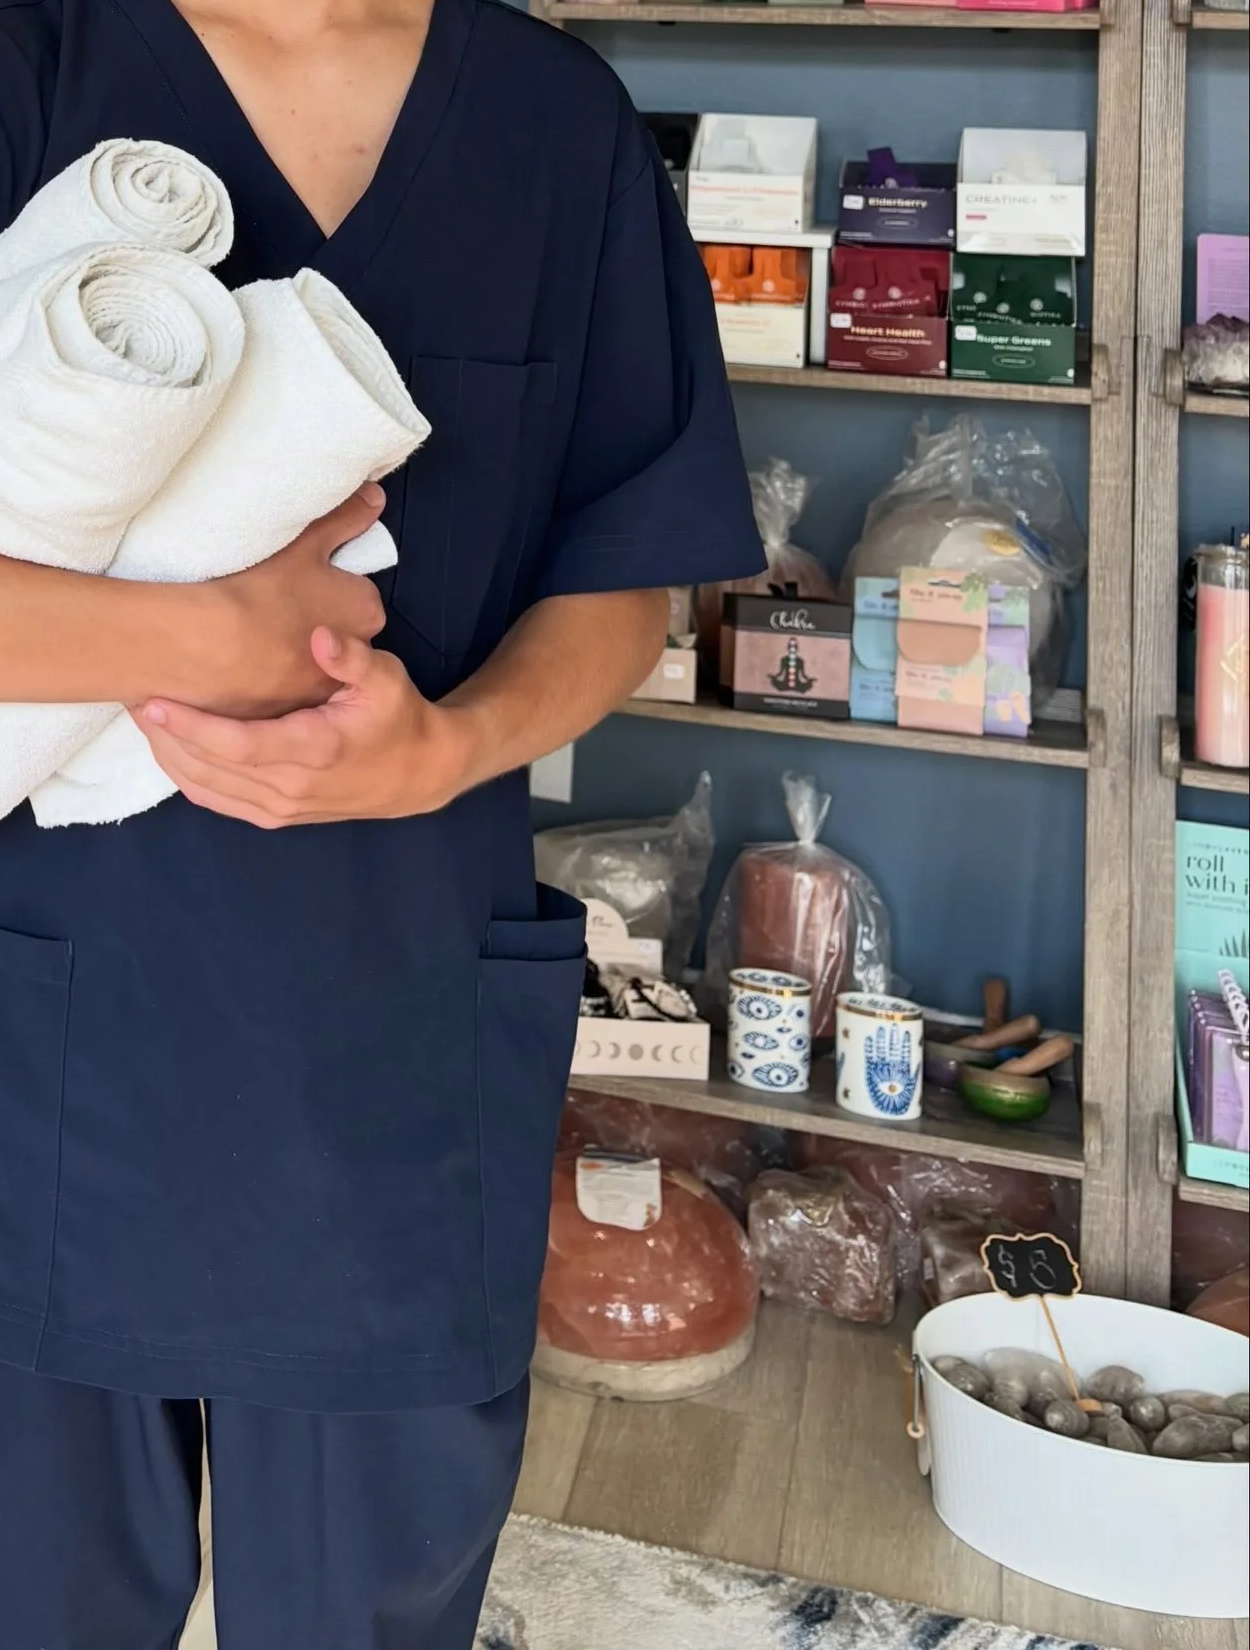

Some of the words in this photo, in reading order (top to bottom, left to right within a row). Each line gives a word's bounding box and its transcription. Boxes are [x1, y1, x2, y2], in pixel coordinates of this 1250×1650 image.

[868, 197, 928, 209] Elderberry
[850, 326, 884, 337] Heart
[885, 327, 927, 339] Health
[976, 333, 1010, 345] Super
[1011, 335, 1053, 347] Greens
[1187, 854, 1224, 872] roll
[1185, 873, 1235, 894] with
